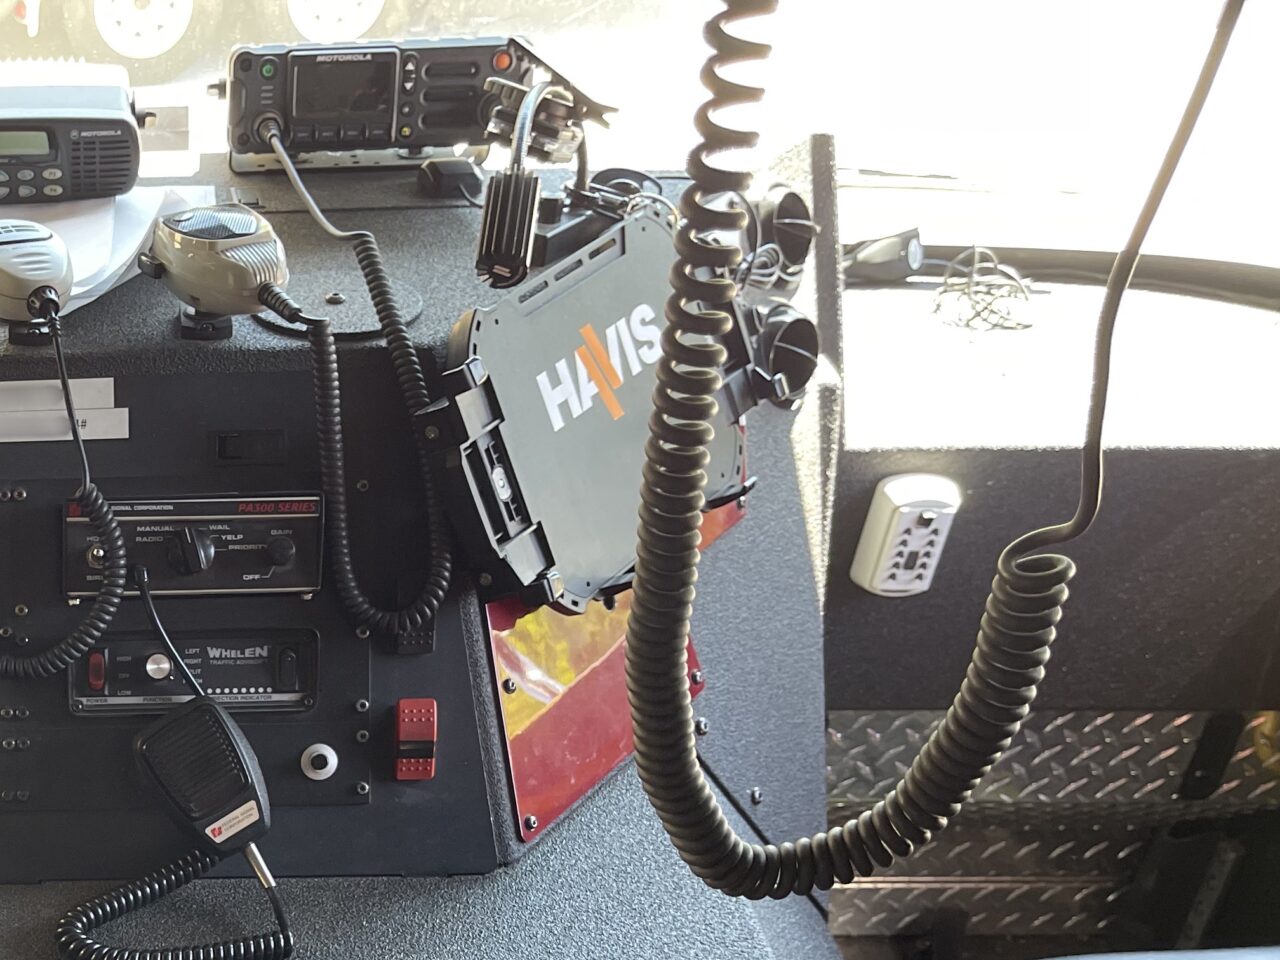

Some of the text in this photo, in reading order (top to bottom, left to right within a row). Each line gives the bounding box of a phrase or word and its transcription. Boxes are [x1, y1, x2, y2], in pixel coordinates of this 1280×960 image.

[317, 53, 373, 62] MOTOROLA
[80, 129, 122, 138] MOTOROLA
[535, 303, 664, 432] HAVIS
[238, 502, 315, 513] PA300 SERIES
[206, 646, 268, 658] WHELEN
